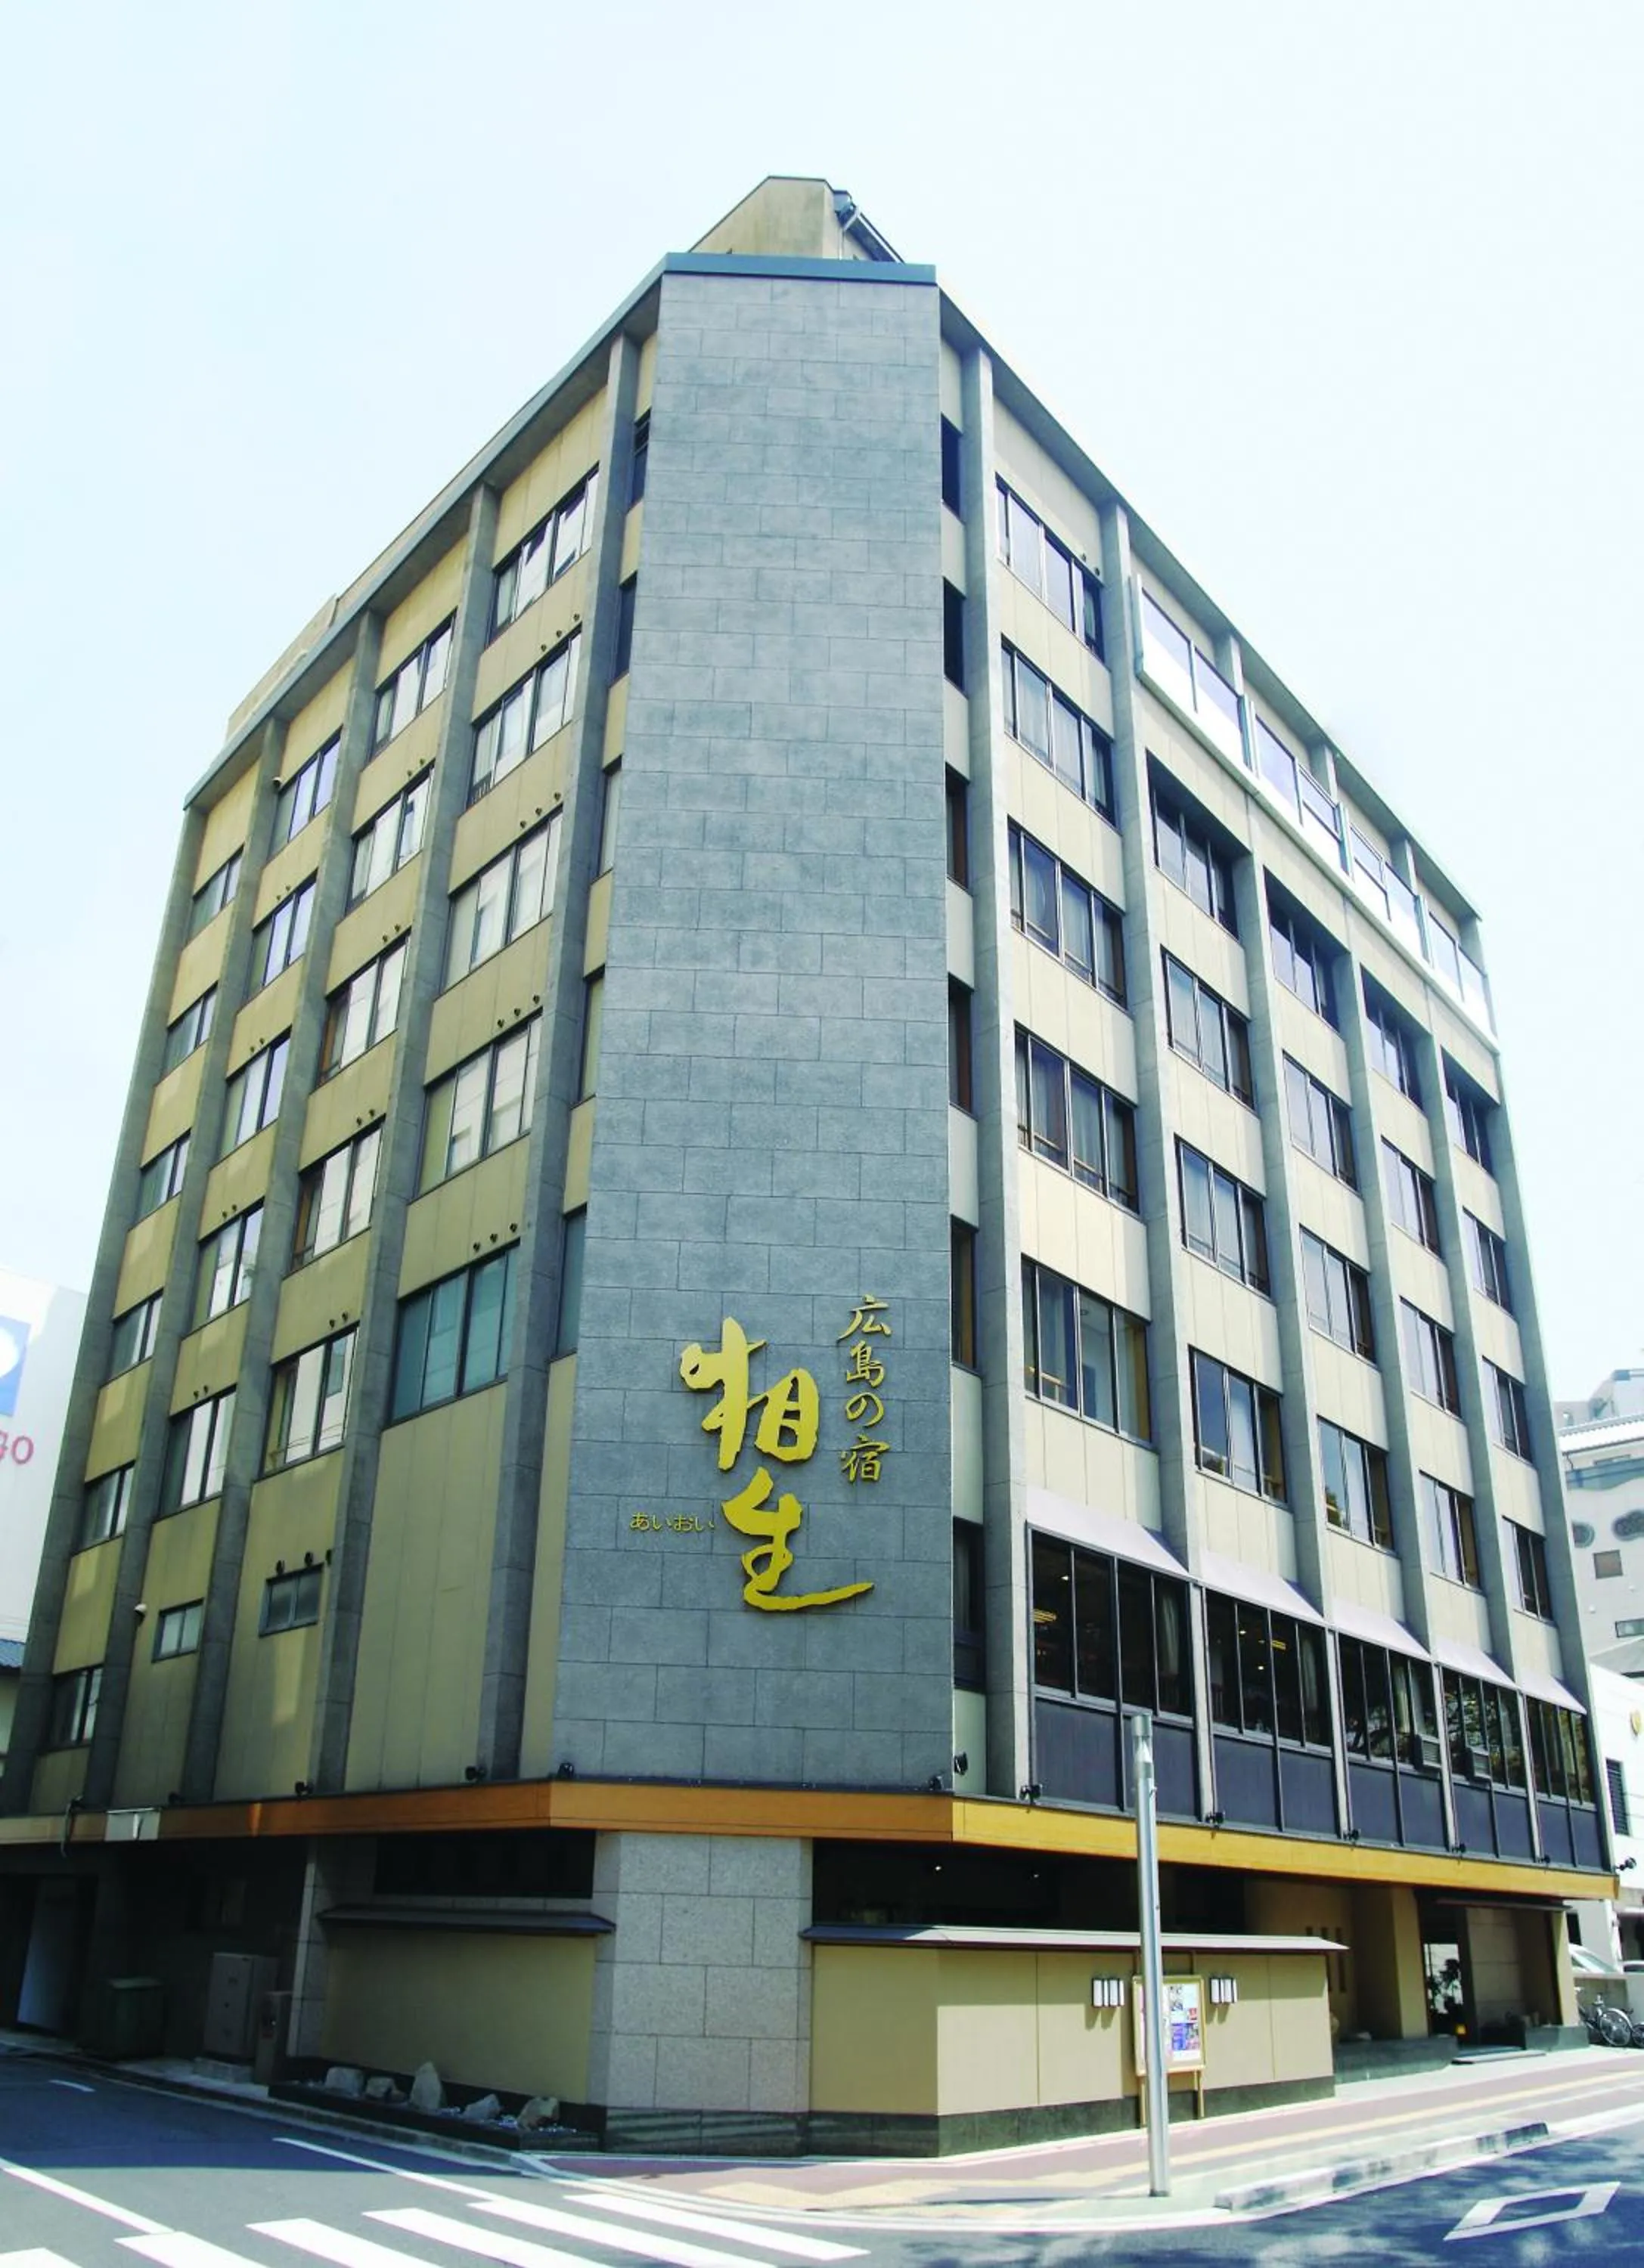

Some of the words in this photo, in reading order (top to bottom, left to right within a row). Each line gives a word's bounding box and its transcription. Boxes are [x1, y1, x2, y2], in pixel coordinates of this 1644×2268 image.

[680, 1315, 875, 1611] 相生
[837, 1294, 892, 1483] 広島の宿
[629, 1512, 715, 1533] あいおい
